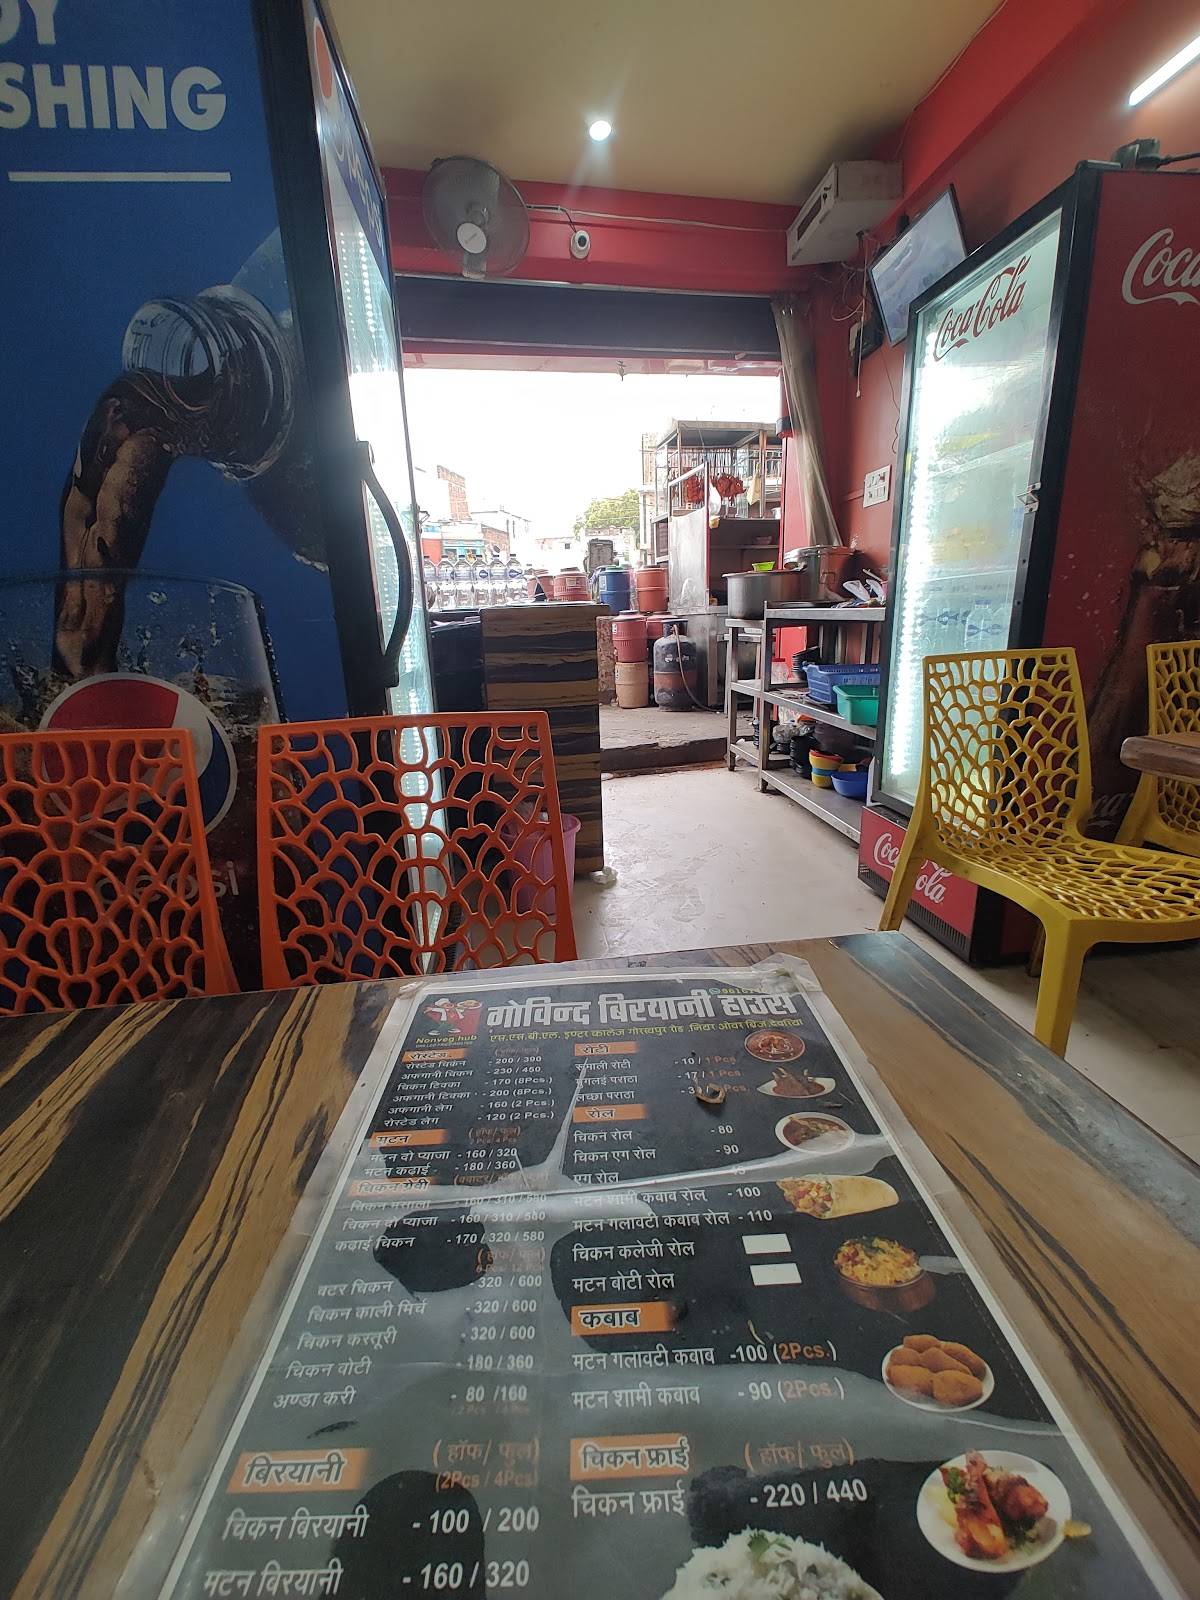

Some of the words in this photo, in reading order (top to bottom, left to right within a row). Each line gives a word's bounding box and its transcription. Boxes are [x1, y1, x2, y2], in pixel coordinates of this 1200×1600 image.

[933, 255, 1031, 362] Coca-Cola
[416, 1036, 455, 1044] Nonveg
[494, 1067, 512, 1075] 230
[495, 1057, 514, 1065] 200
[489, 1089, 509, 1097] 200
[492, 1078, 511, 1086] 170
[488, 1099, 508, 1109] 160
[485, 1112, 506, 1122] 120
[573, 1129, 607, 1144] चिकन
[611, 1127, 633, 1141] रोल
[718, 1124, 733, 1135] 80
[370, 1152, 397, 1164] मटन
[466, 1149, 486, 1159] 160
[496, 1147, 518, 1158] 320
[573, 1149, 608, 1164] चिकन
[611, 1148, 630, 1163] एग
[632, 1146, 656, 1160] रोल
[723, 1144, 739, 1155] 90
[364, 1167, 394, 1178] मटन
[463, 1161, 483, 1172] 180
[494, 1160, 516, 1170] 360
[595, 1169, 619, 1184] रोल
[680, 1186, 707, 1202] रोल
[736, 1186, 761, 1199] 100
[460, 1214, 480, 1224] 160
[491, 1212, 513, 1222] 310
[572, 1219, 604, 1233] मटन
[703, 1209, 730, 1225] रोल
[747, 1209, 773, 1223] 110
[375, 1234, 416, 1250] चिकन
[455, 1233, 478, 1244] 170
[488, 1231, 511, 1243] 320
[523, 1230, 545, 1242] 580
[572, 1243, 614, 1262] चिकन
[617, 1237, 665, 1260] कलेजी
[668, 1238, 695, 1257] रोल
[350, 1278, 394, 1296] चिकन
[478, 1275, 502, 1288] 320
[518, 1274, 543, 1287] 600
[572, 1277, 606, 1293] मटन
[645, 1268, 675, 1288] रोल
[307, 1304, 352, 1324] चिकन
[355, 1299, 394, 1320] काली
[474, 1300, 499, 1313] 320
[511, 1299, 538, 1313] 600
[579, 1308, 641, 1330] कबाब
[296, 1331, 343, 1351] चिकन
[470, 1326, 497, 1341] 320
[509, 1325, 536, 1340] 600
[285, 1360, 335, 1380] चिकन
[466, 1355, 493, 1371] 180
[506, 1354, 534, 1370] 360
[572, 1353, 606, 1372] मटन
[611, 1343, 671, 1369] गलावटी
[323, 1384, 357, 1407] करी
[465, 1386, 485, 1402] 80
[572, 1390, 609, 1410] मटन
[613, 1381, 652, 1408] शामी
[749, 1381, 772, 1400] 90
[578, 1441, 641, 1472] चिकन
[571, 1484, 635, 1518] चिकन
[639, 1479, 686, 1517] फ्राई
[763, 1482, 805, 1509] 220
[826, 1478, 868, 1503] 440
[221, 1507, 287, 1542] चिकन
[429, 1508, 470, 1534] 100
[496, 1505, 540, 1532] 200
[203, 1569, 256, 1598] मटन
[420, 1561, 463, 1590] 160
[485, 1559, 531, 1588] 320
